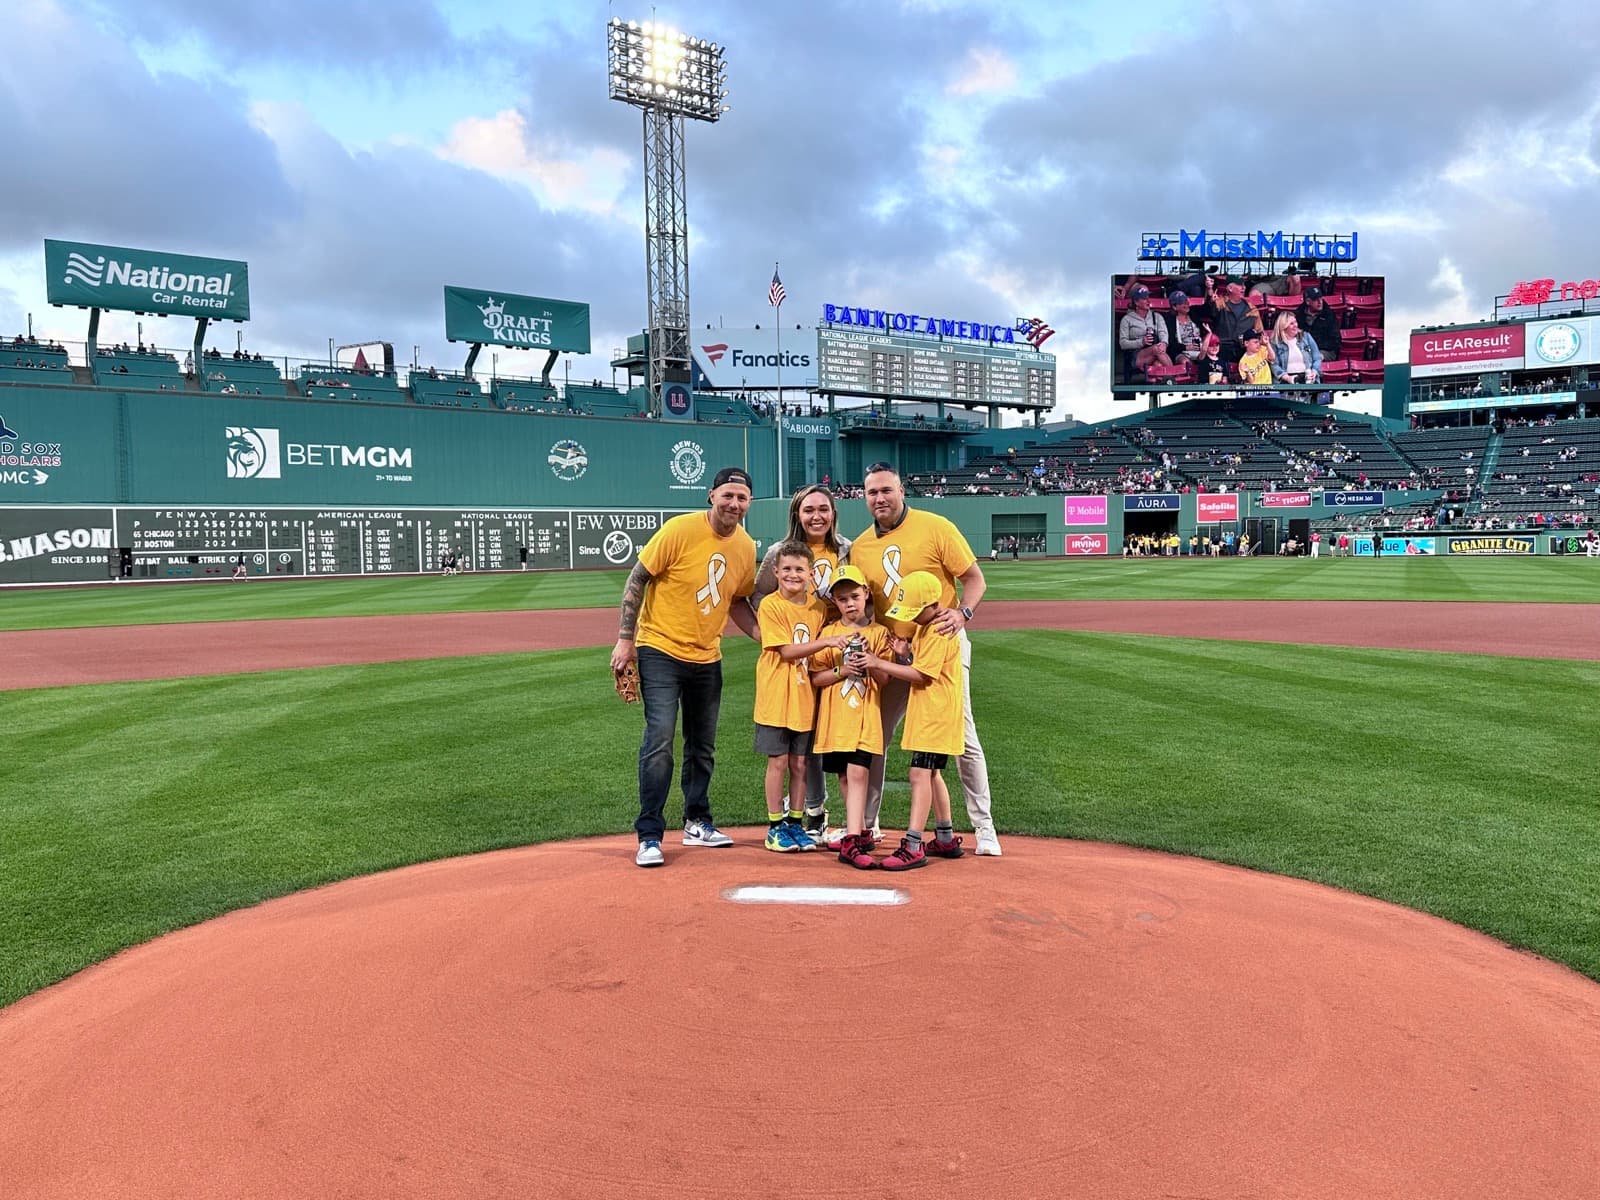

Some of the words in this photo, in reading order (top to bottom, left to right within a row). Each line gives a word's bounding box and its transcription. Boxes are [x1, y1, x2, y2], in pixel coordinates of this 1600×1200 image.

[1179, 229, 1358, 259] MassMutual
[1561, 280, 1600, 300] ne
[152, 292, 177, 304] Car
[182, 295, 227, 308] Rental
[483, 312, 552, 332] DRAFT
[824, 303, 886, 329] BANK
[893, 313, 919, 332] OF
[926, 317, 1015, 343] AMERICA
[493, 326, 552, 345] KINGS
[848, 334, 868, 342] LEAGUE
[1424, 333, 1510, 352] CLEAResult
[732, 350, 810, 367] Fanatics
[790, 425, 831, 435] ABIOMED
[21, 442, 61, 456] SOX
[671, 440, 691, 454] IBEW
[287, 444, 412, 468] BETMGM
[1282, 495, 1310, 505] TICKET
[156, 511, 217, 519] FENWAY
[229, 511, 266, 519] PARK
[1077, 505, 1104, 515] Mobile
[610, 515, 656, 529] WEBB
[144, 530, 174, 538] CHICAGO
[144, 540, 174, 548] BOSTON
[579, 546, 600, 555] Since
[1072, 540, 1101, 548] IRVING
[1359, 541, 1398, 554] jetlue
[1451, 539, 1503, 552] GRANITE
[1505, 538, 1533, 551] CITY
[86, 555, 108, 563] 1898
[135, 557, 145, 566] AT
[168, 556, 190, 565] BALL
[198, 556, 226, 564] STRIKE
